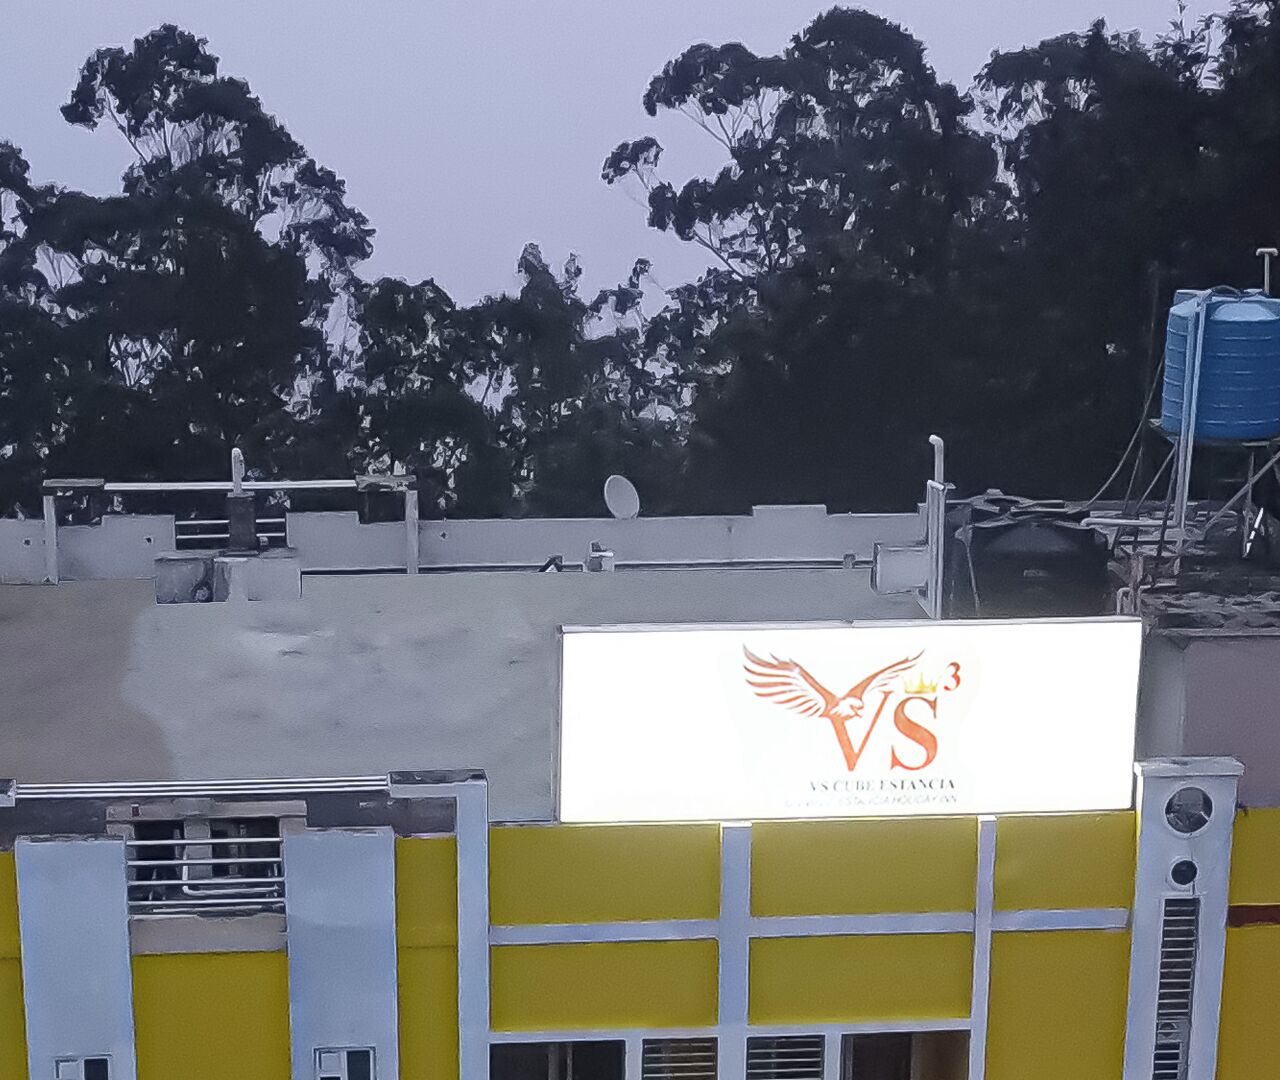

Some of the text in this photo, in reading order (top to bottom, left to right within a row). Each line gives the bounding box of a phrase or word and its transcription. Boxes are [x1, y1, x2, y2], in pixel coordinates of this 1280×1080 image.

[809, 778, 956, 792] VS CUBE ESTANCIA
